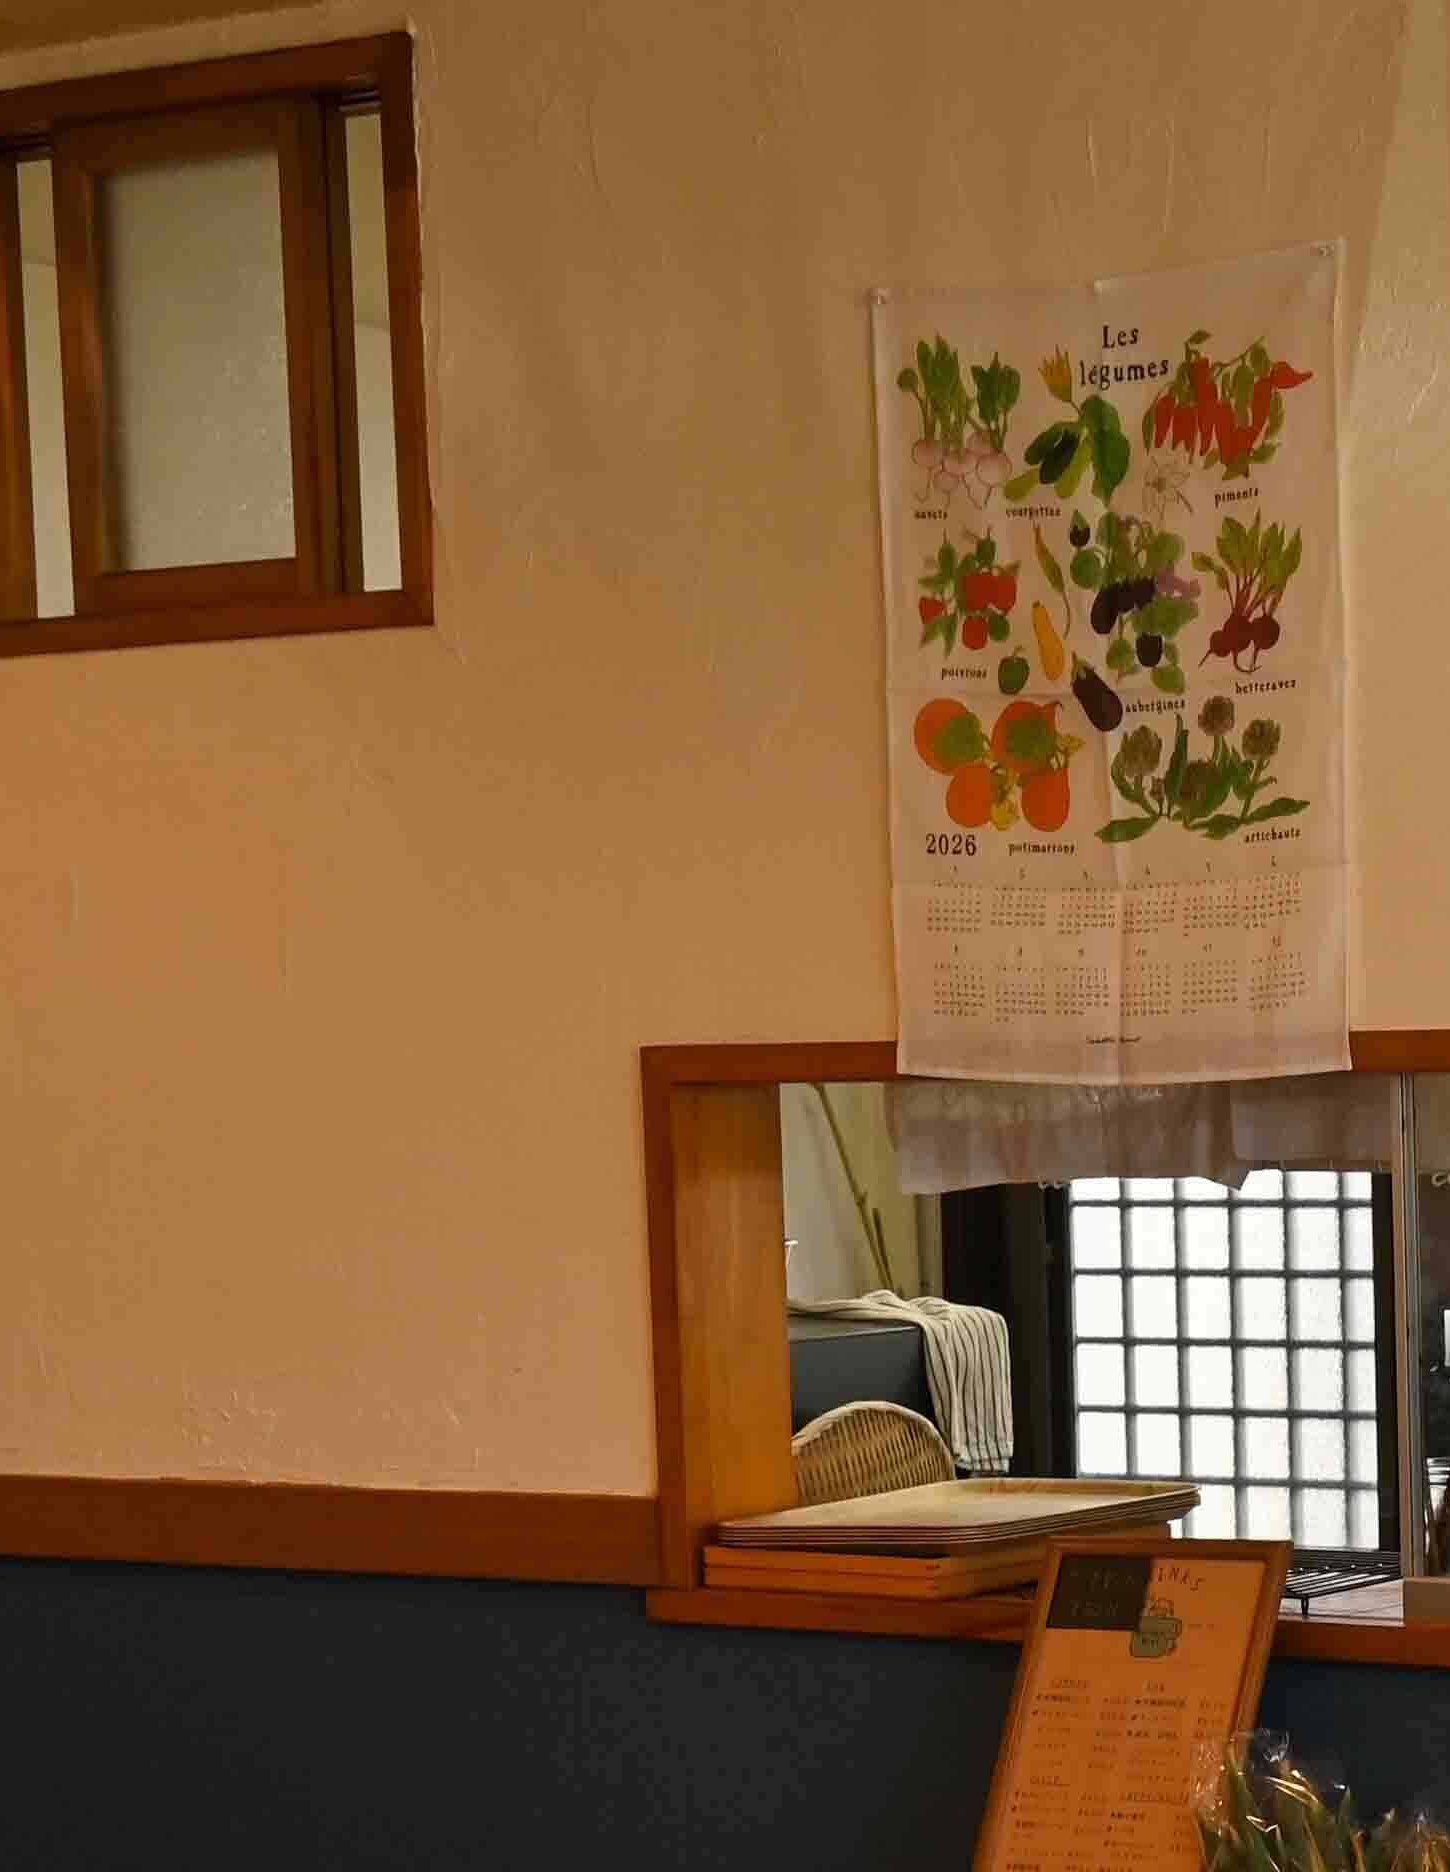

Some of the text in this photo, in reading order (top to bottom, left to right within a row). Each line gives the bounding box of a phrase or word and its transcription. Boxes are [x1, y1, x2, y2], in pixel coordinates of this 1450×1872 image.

[1102, 325, 1139, 349] Les
[1080, 359, 1169, 390] légumes
[925, 832, 978, 857] 2026
